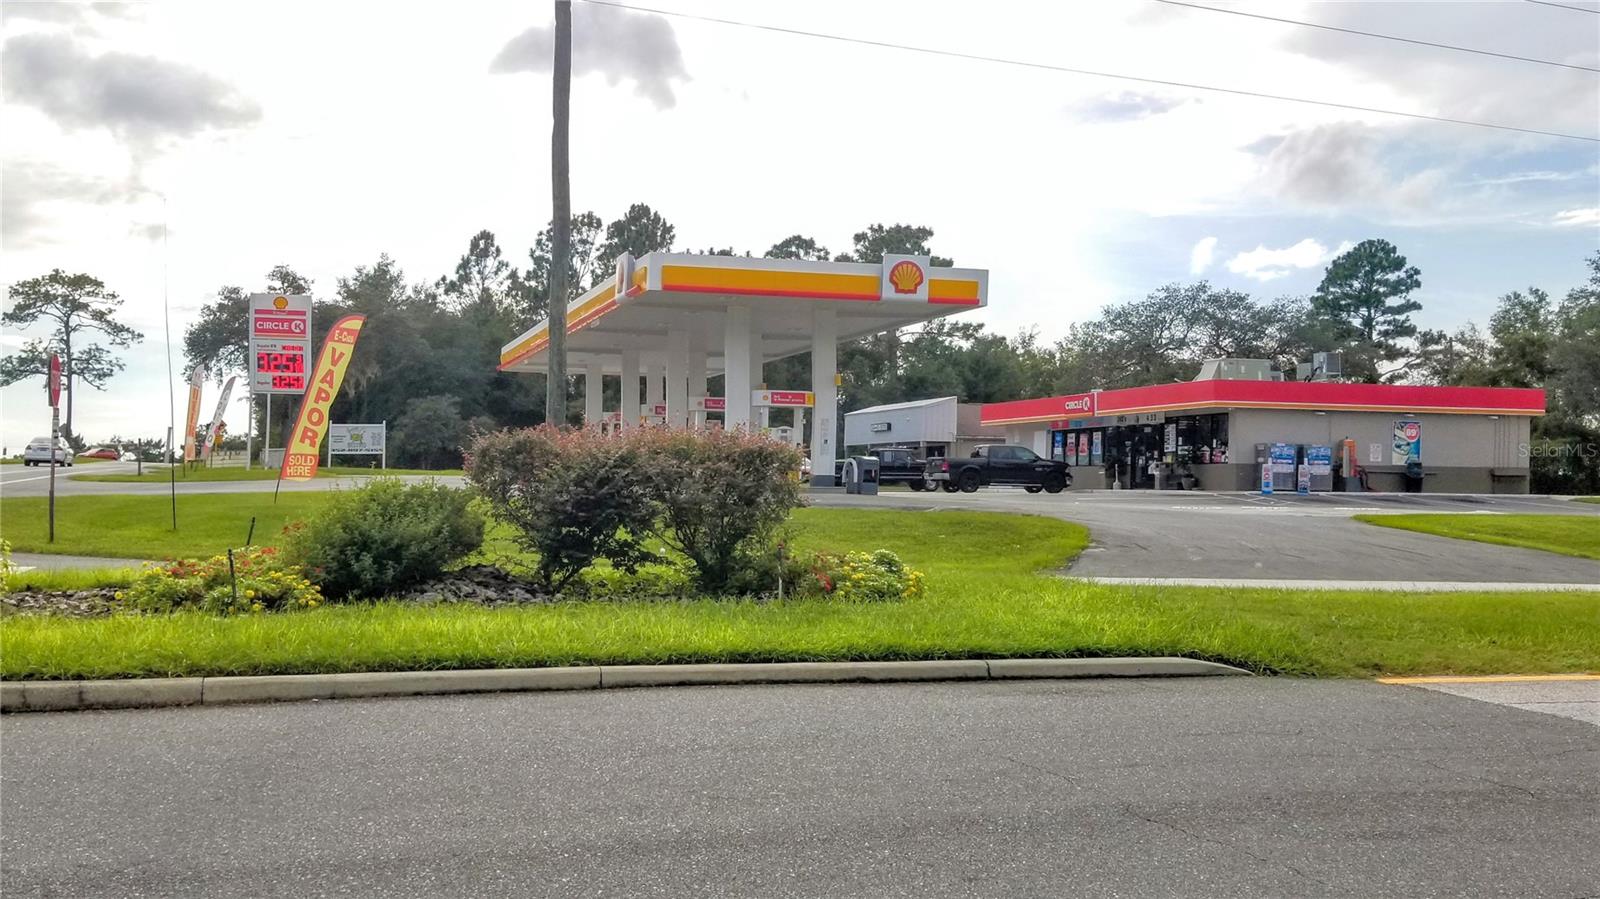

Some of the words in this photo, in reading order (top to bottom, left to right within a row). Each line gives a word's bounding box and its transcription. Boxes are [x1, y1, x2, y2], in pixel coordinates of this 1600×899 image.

[256, 321, 290, 331] CIRCLE
[299, 347, 346, 448] VAPOR
[1065, 401, 1083, 410] CIRCLE
[288, 455, 315, 466] SOLD
[287, 467, 311, 477] HERE
